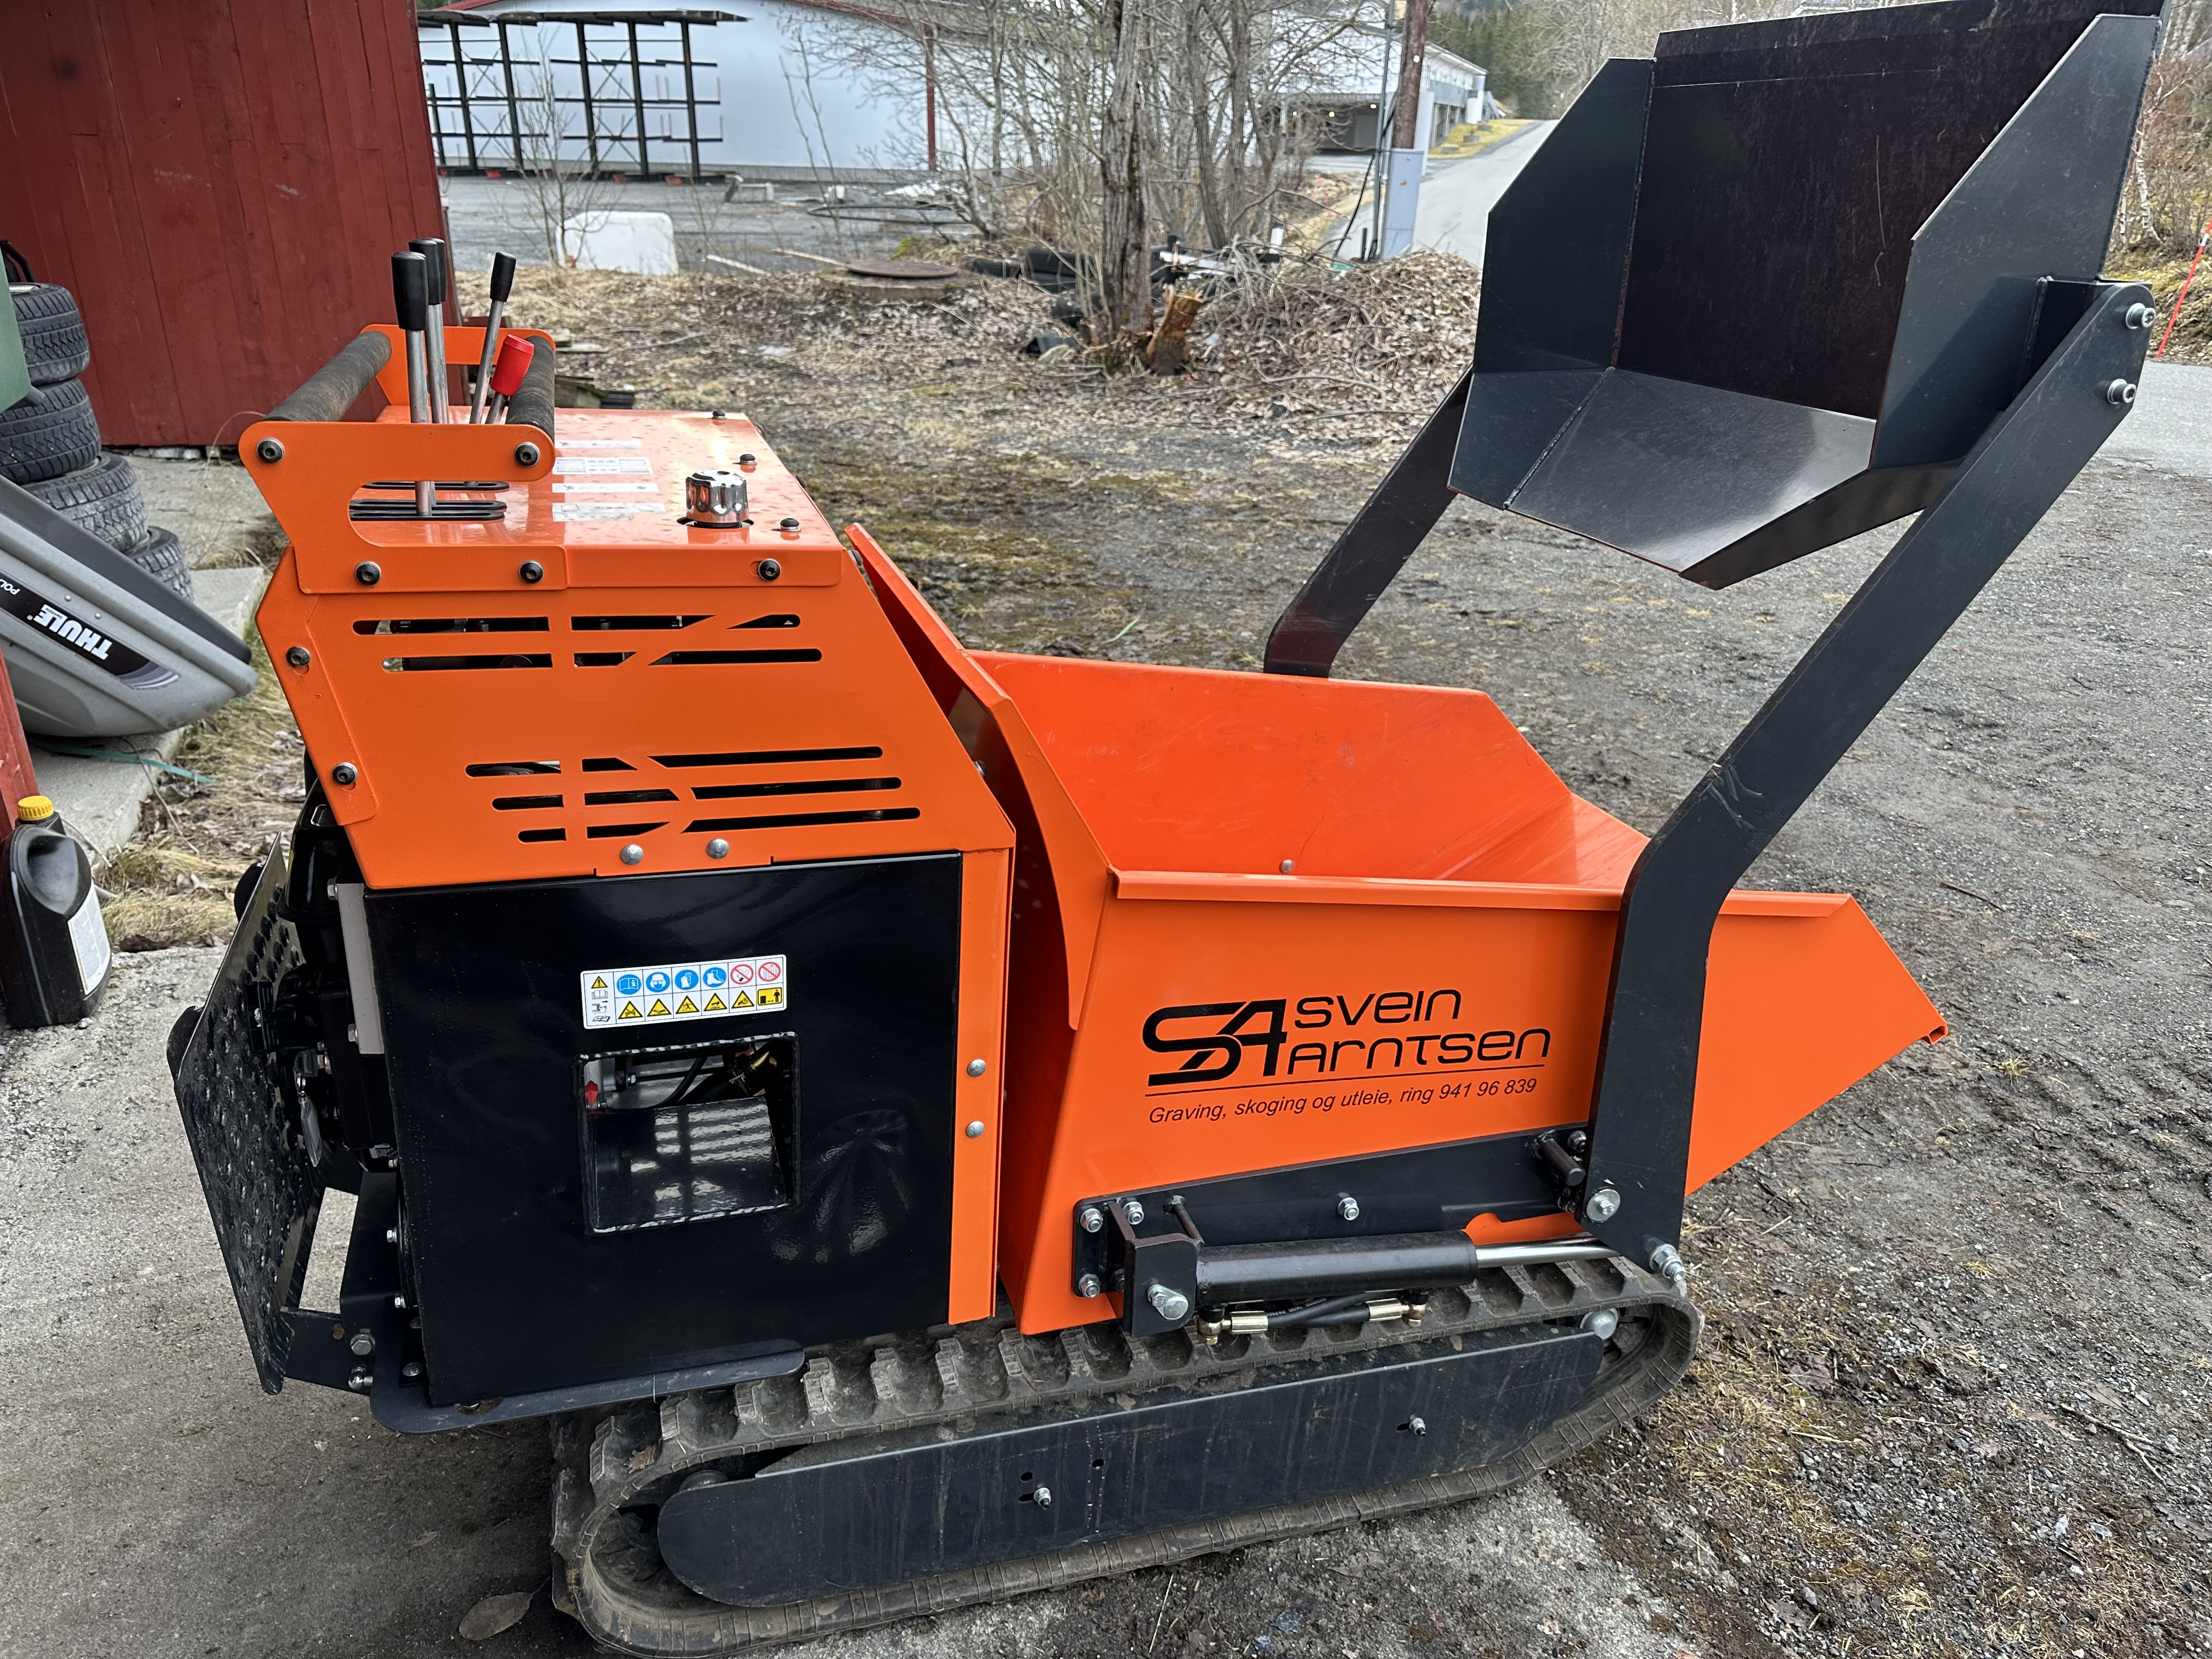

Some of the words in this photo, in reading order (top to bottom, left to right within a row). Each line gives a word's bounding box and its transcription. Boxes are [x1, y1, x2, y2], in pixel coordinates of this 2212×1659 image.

[0, 579, 20, 595] POL
[33, 604, 112, 660] THULE
[1149, 1104, 1227, 1123] Graving,
[1234, 1096, 1307, 1116] skoging
[1312, 1096, 1336, 1112] og
[1340, 1089, 1392, 1107] utleie,
[1400, 1087, 1434, 1104] ring
[1439, 1083, 1472, 1099] 941
[1476, 1080, 1500, 1097] 96
[1504, 1077, 1537, 1094] 839
